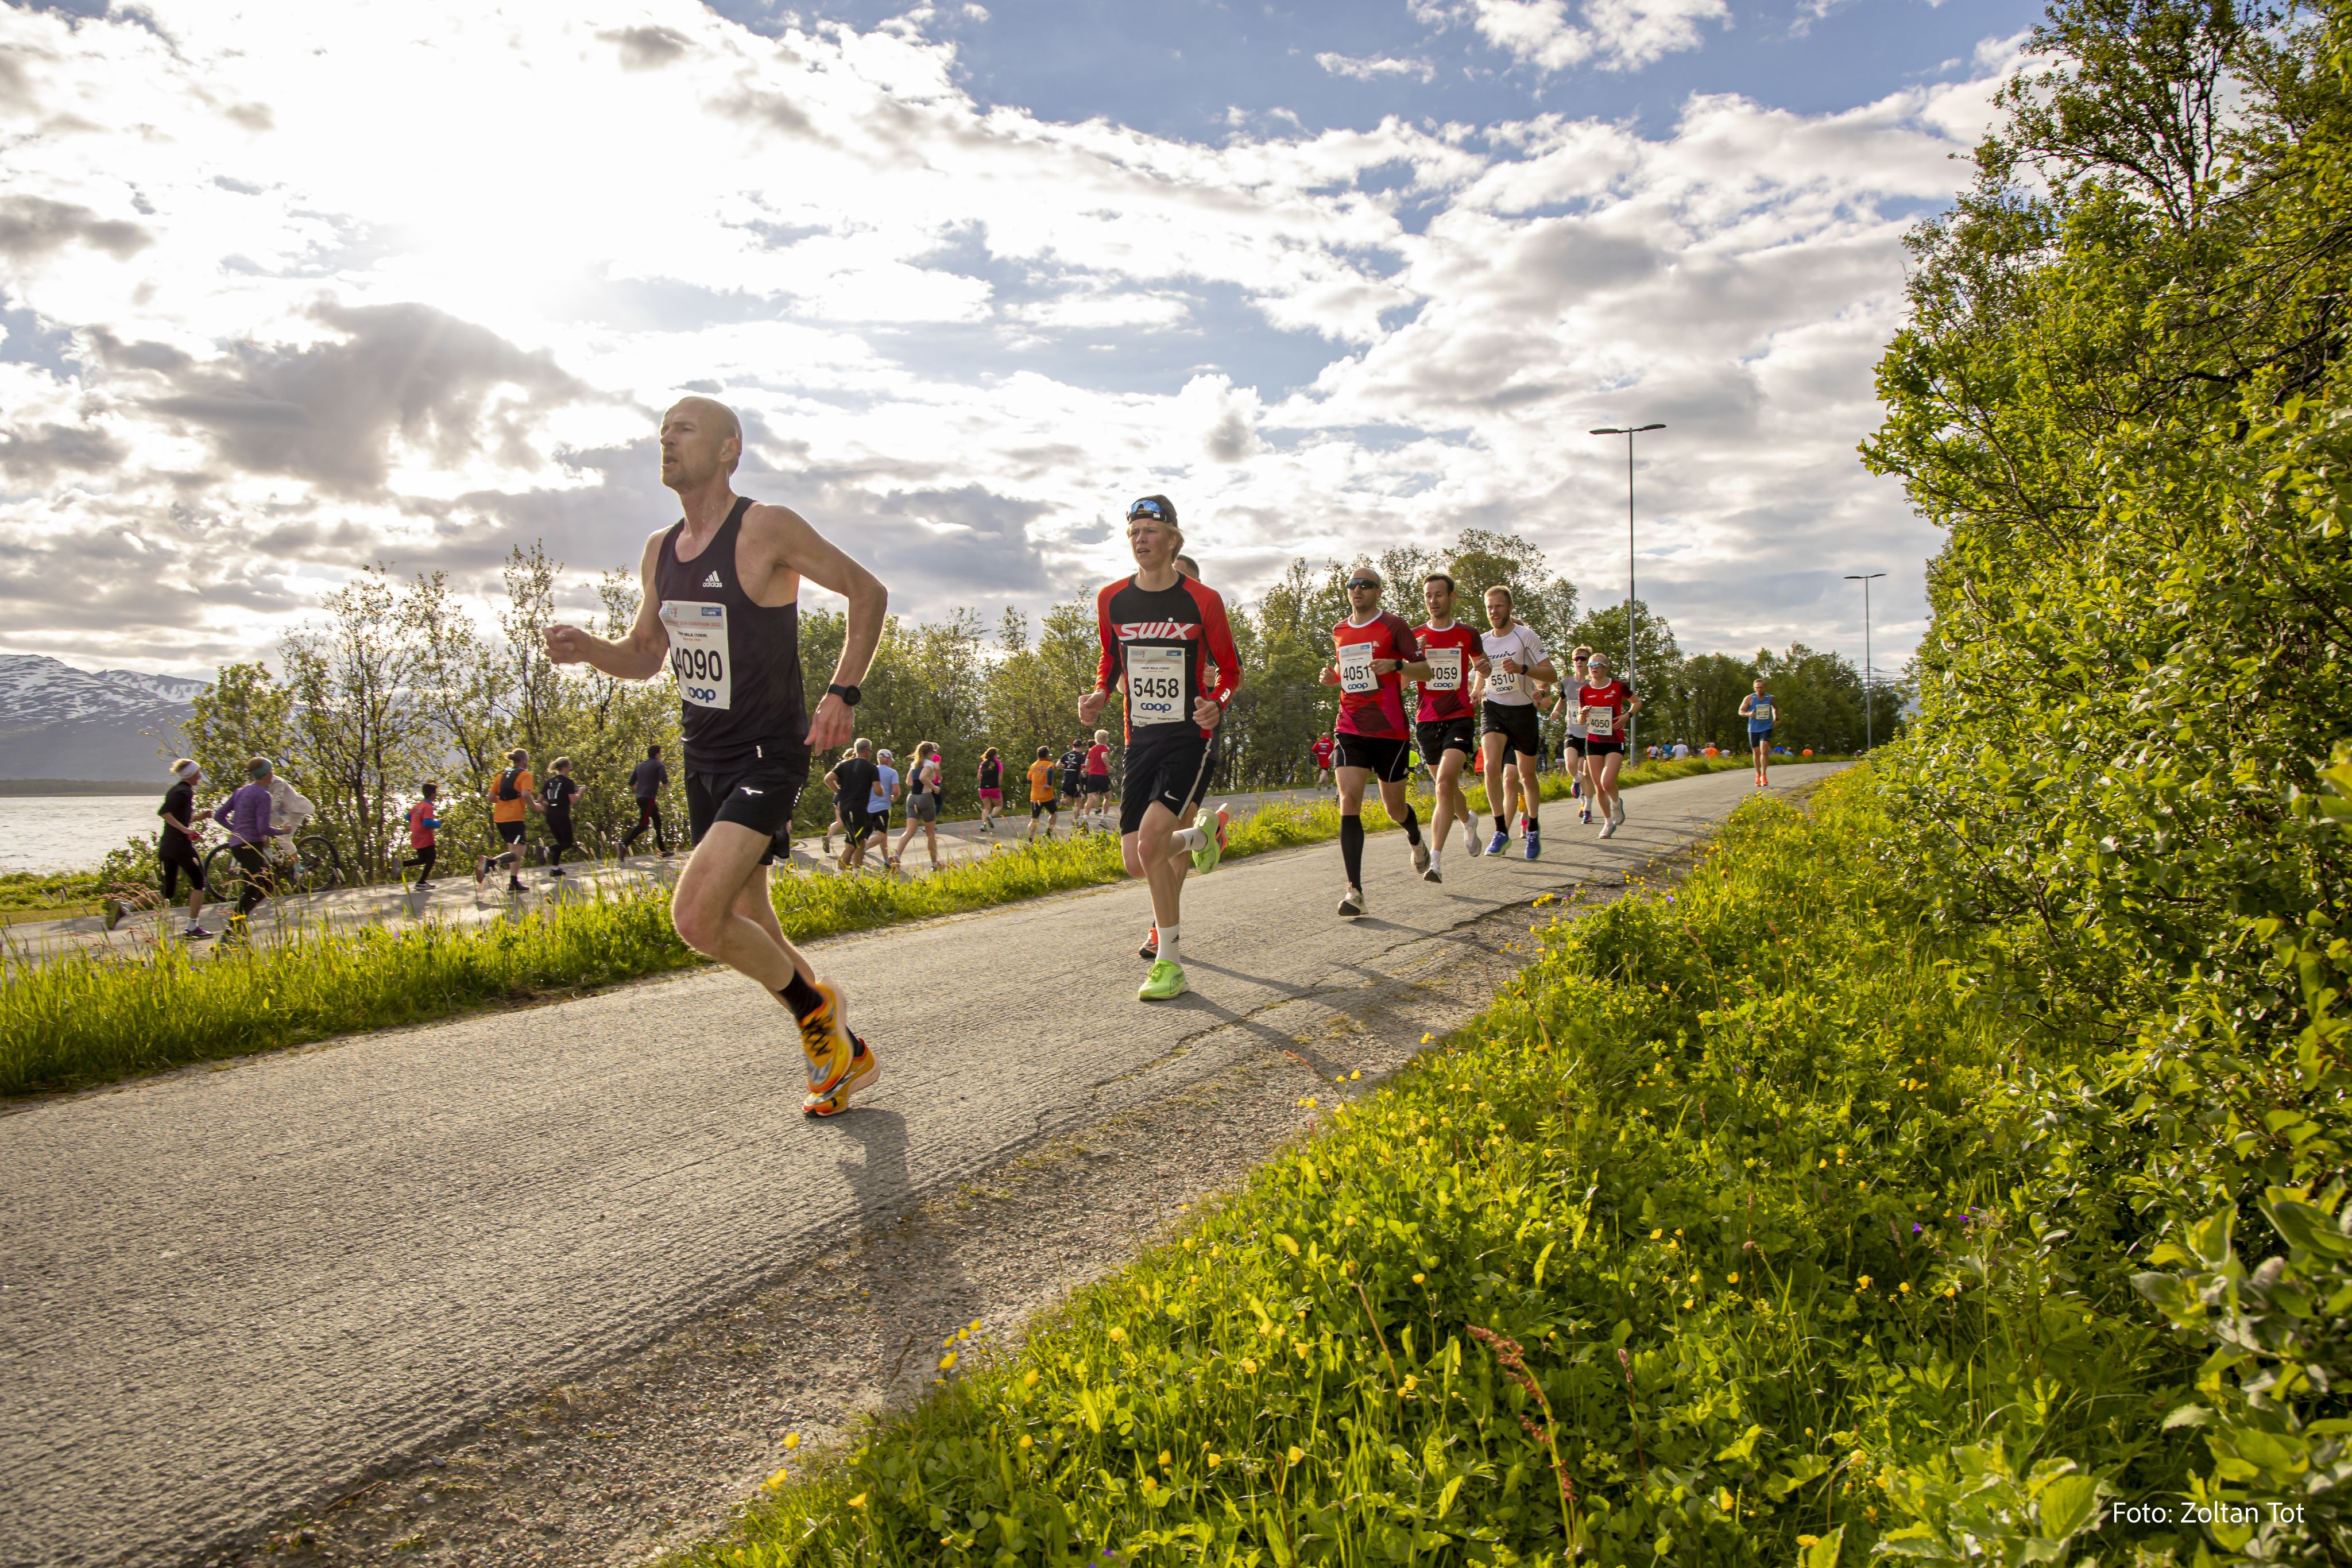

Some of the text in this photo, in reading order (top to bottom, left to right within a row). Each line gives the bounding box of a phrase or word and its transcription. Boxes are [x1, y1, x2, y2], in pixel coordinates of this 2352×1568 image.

[675, 646, 722, 682] 4090
[1343, 664, 1370, 681] 4051
[1491, 672, 1515, 686] 5510
[687, 686, 717, 703] oop
[1134, 677, 1179, 699] 5458
[1140, 702, 1172, 713] coop
[1591, 719, 1610, 728] 4050
